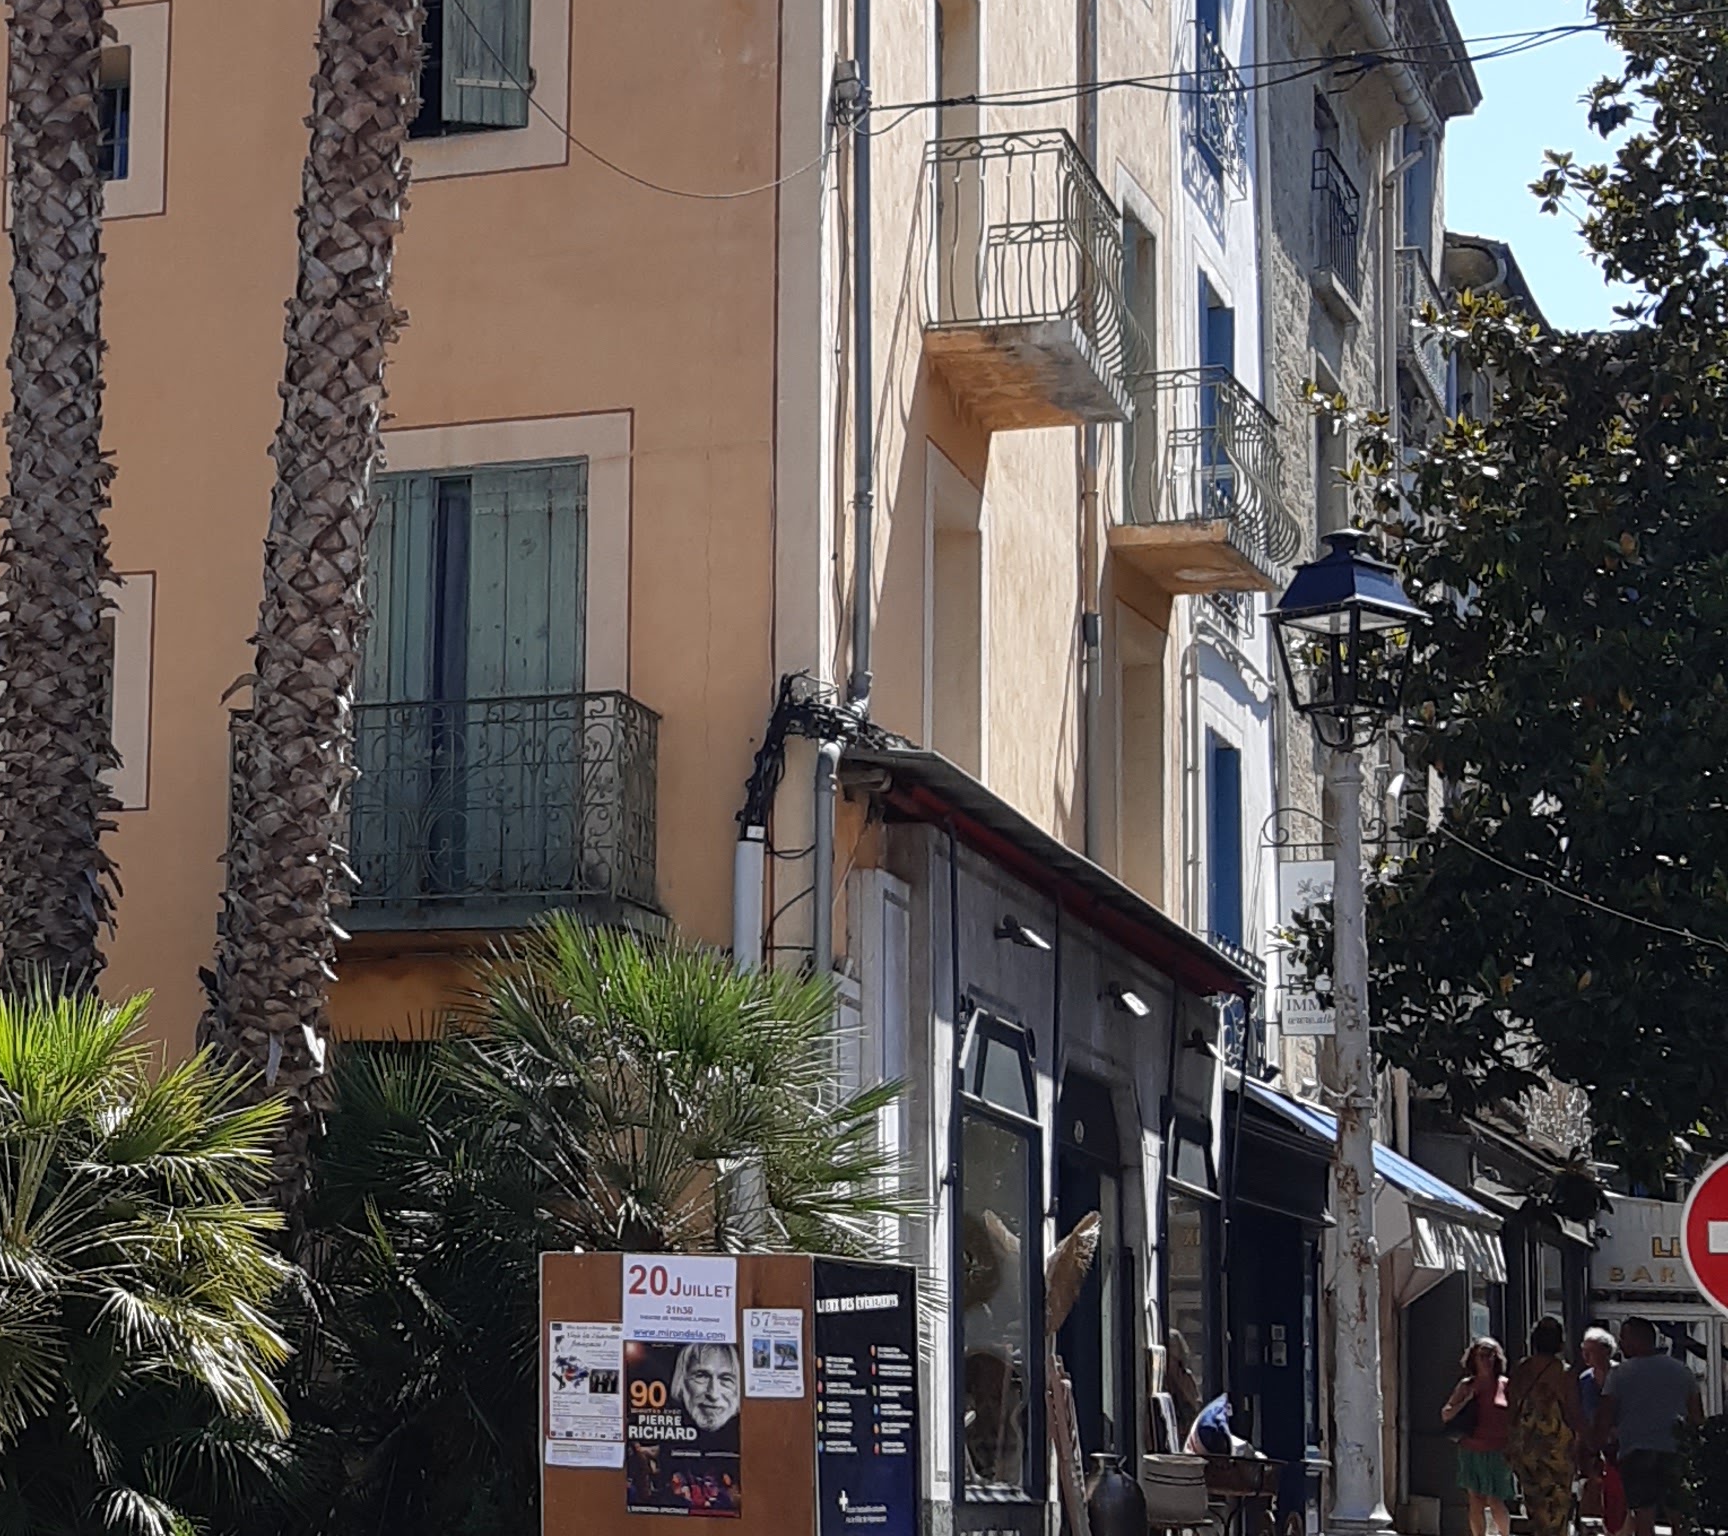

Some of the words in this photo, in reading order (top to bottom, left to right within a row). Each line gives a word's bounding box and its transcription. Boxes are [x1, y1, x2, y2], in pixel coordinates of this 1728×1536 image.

[1288, 1013, 1332, 1024] www.alb
[628, 1264, 668, 1296] 20
[669, 1276, 731, 1298] JUILLET
[1609, 1265, 1677, 1283] BAR
[630, 1380, 667, 1407] 90
[638, 1414, 682, 1426] PIERRE
[628, 1425, 698, 1441] RICHARD
